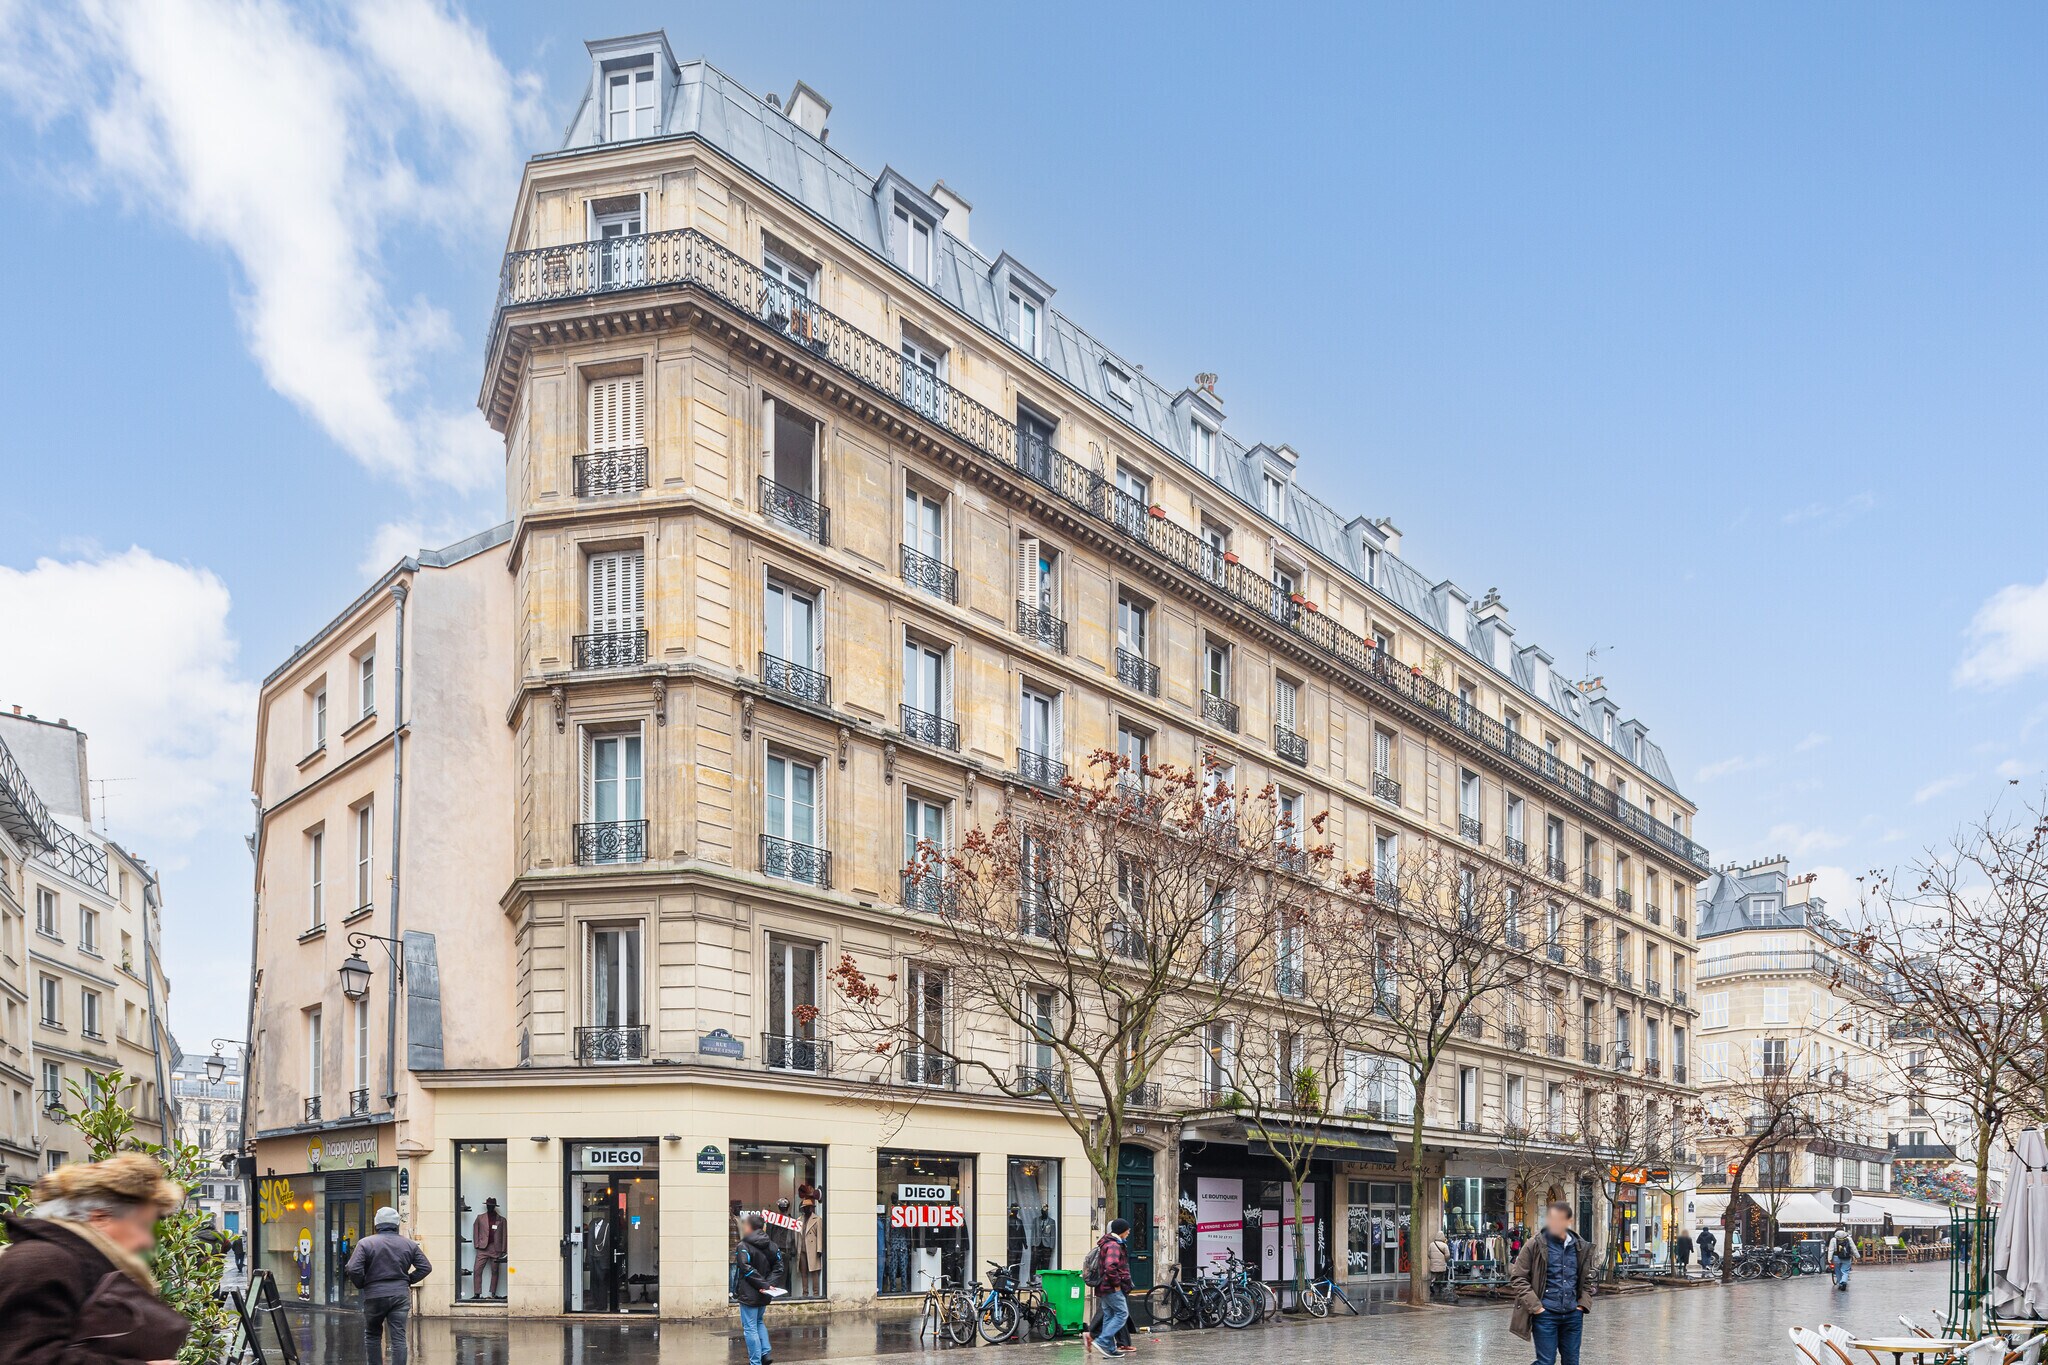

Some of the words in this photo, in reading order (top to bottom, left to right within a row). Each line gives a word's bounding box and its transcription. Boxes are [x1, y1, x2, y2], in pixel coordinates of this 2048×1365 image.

[591, 1150, 642, 1164] DIEGO
[904, 1186, 946, 1199] DIEGO
[761, 1208, 804, 1233] SOLDES
[891, 1205, 964, 1228] SOLDES
[1267, 1248, 1274, 1257] B
